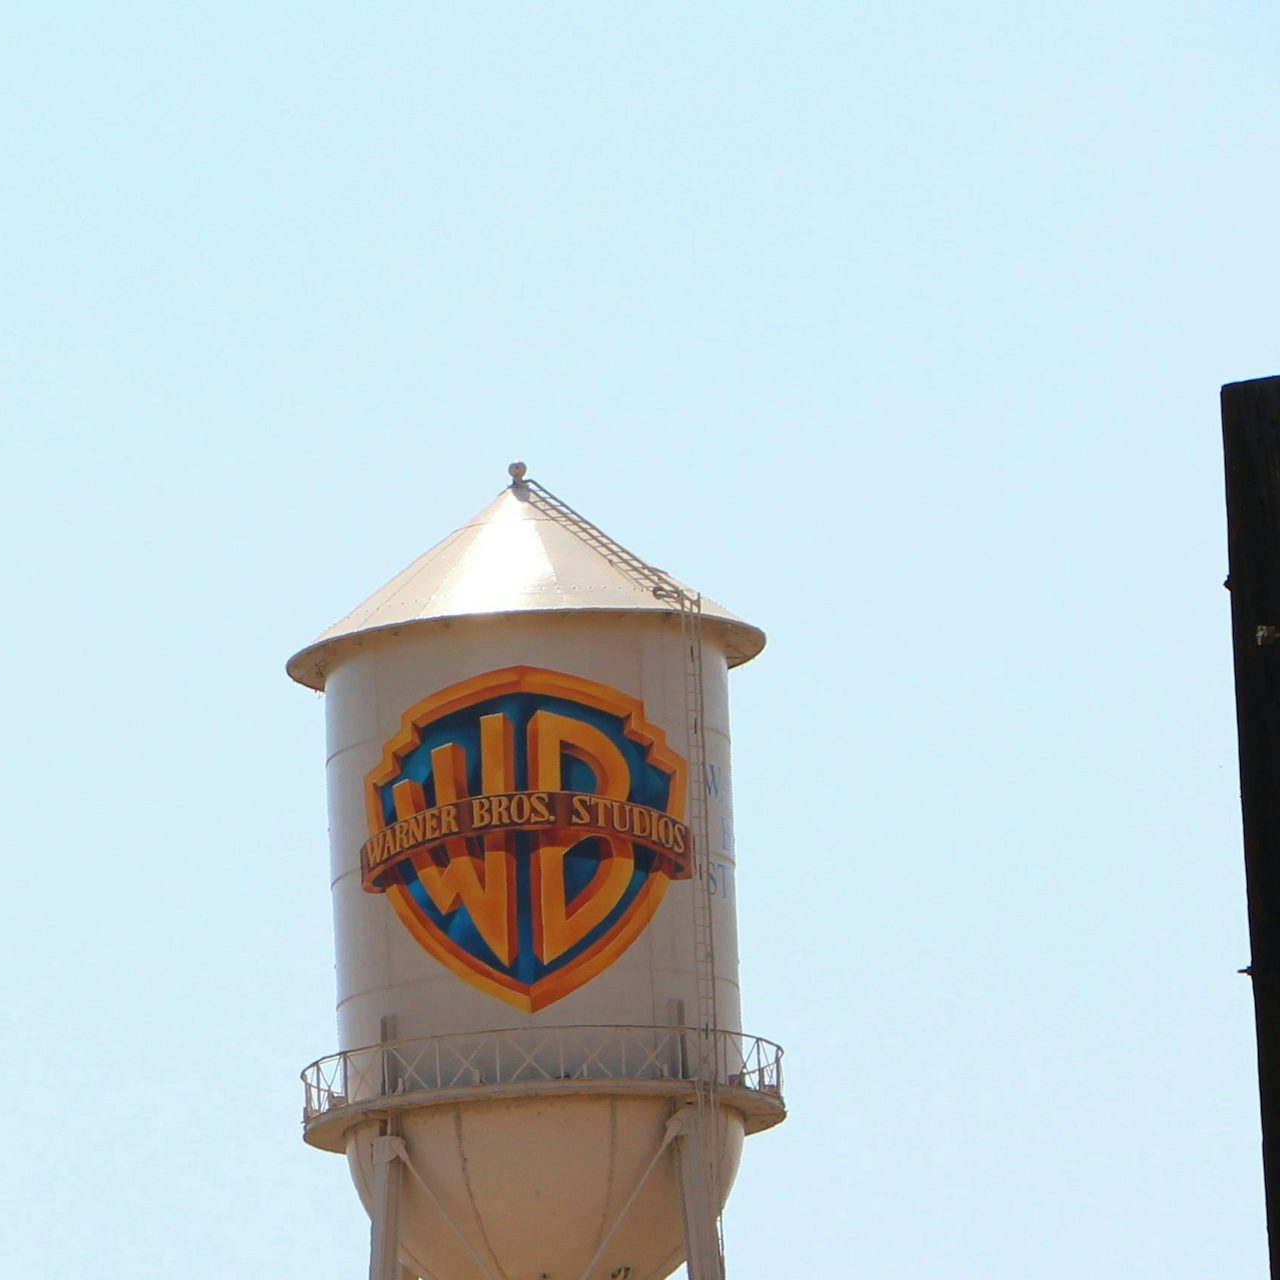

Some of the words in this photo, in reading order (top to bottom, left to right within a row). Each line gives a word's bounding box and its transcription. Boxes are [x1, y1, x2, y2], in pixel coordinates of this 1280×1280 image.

[366, 805, 460, 867] WARNER
[471, 793, 556, 829] BROS.
[571, 794, 686, 854] STUDIOS
[391, 709, 635, 967] WB
